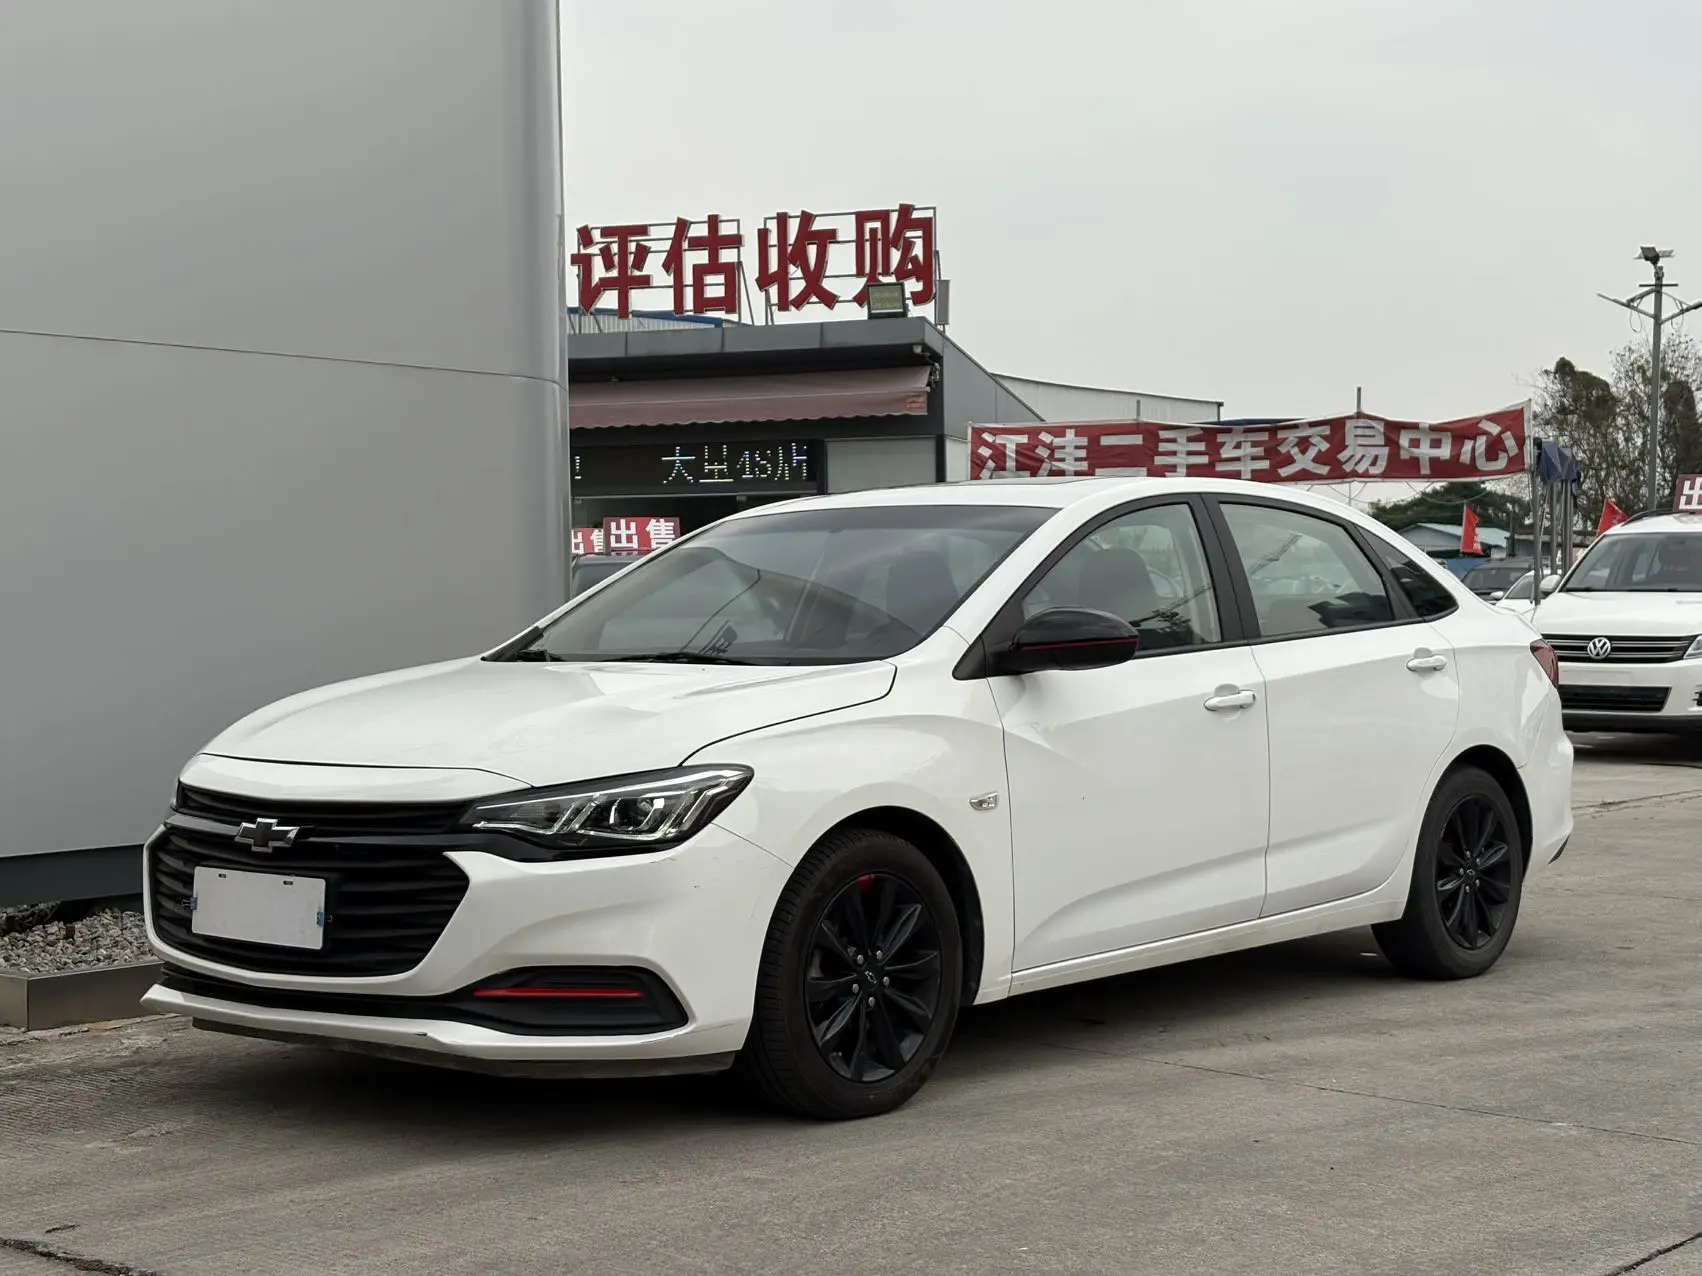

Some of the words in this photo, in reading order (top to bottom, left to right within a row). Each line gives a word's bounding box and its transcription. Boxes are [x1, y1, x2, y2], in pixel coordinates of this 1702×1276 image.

[571, 203, 937, 320] 评估收购
[610, 518, 676, 549] 出售
